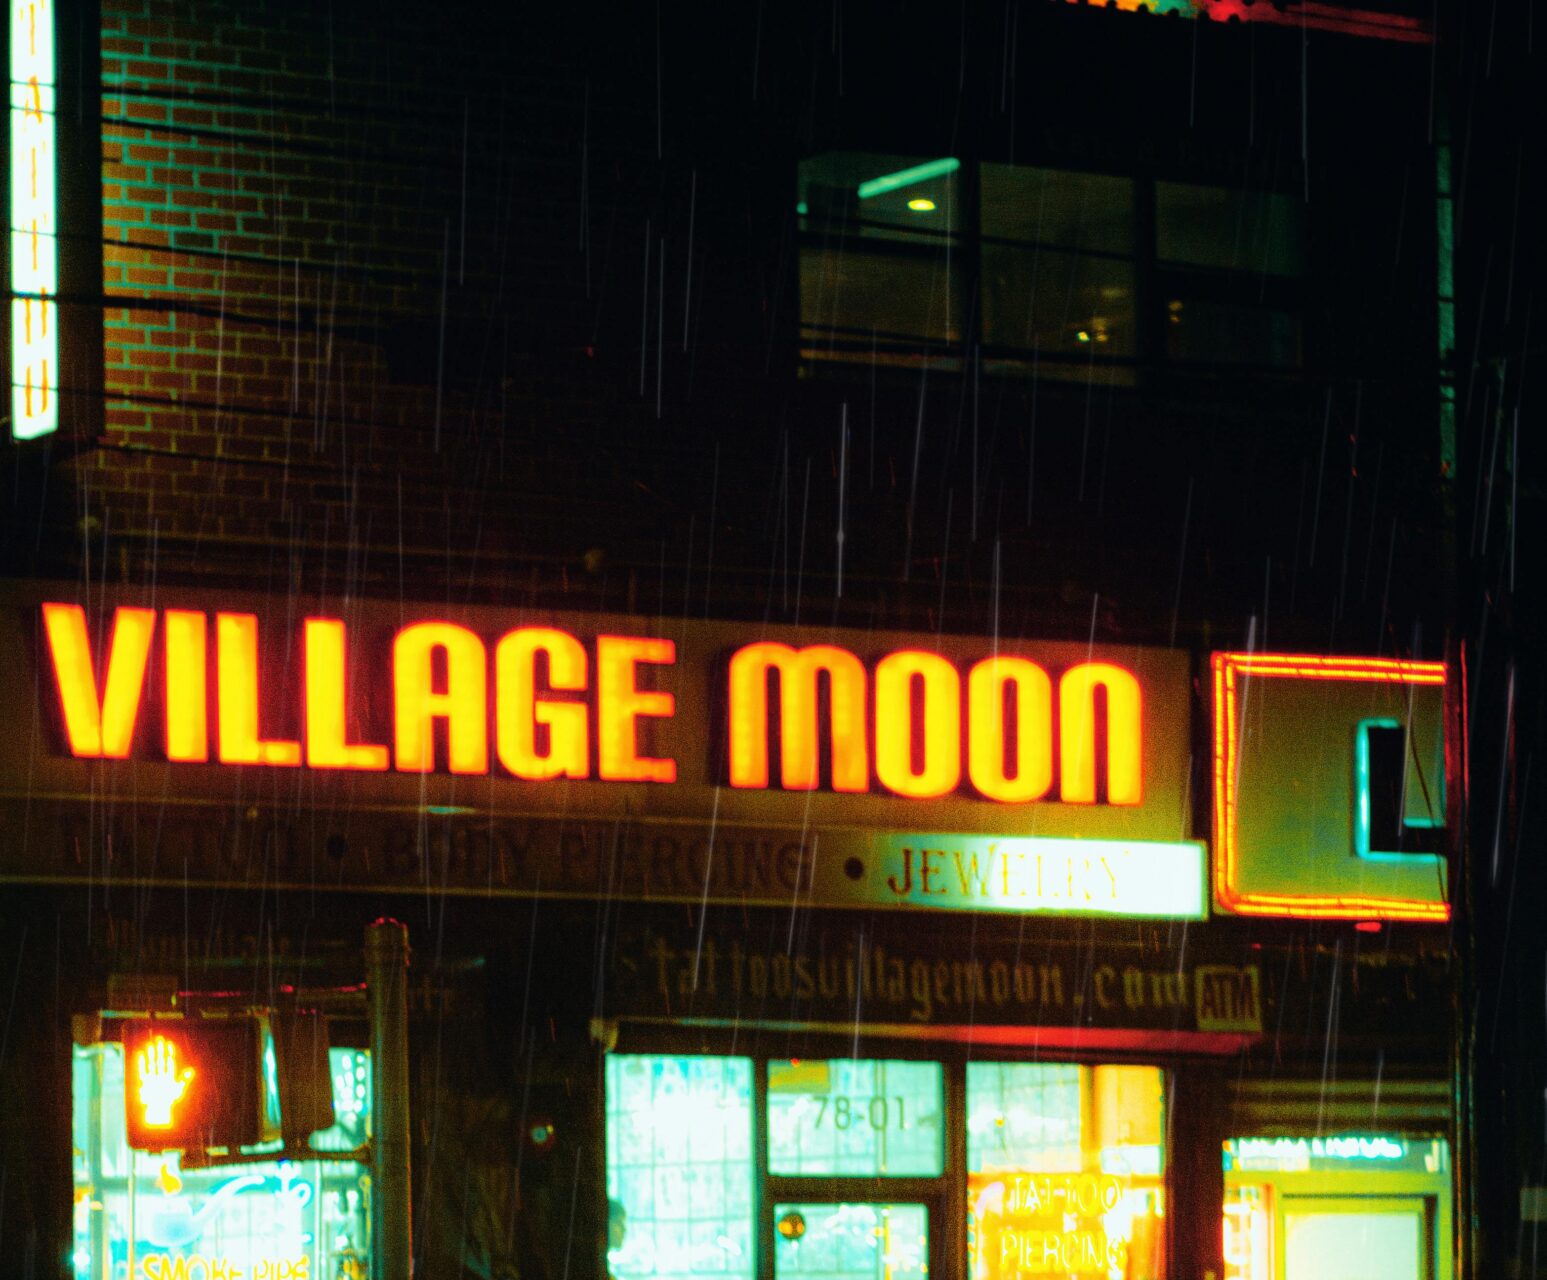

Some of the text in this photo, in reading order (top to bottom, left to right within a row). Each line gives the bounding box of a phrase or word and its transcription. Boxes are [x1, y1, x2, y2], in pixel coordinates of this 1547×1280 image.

[41, 601, 1143, 807] VILLAGE MOON
[559, 829, 812, 895] PIERCING
[888, 845, 1130, 901] JEWELRY
[1201, 971, 1256, 1019] ATM
[814, 1096, 906, 1131] 78-01
[1008, 1174, 1121, 1216] TATTOO
[1000, 1231, 1127, 1272] PIERCING
